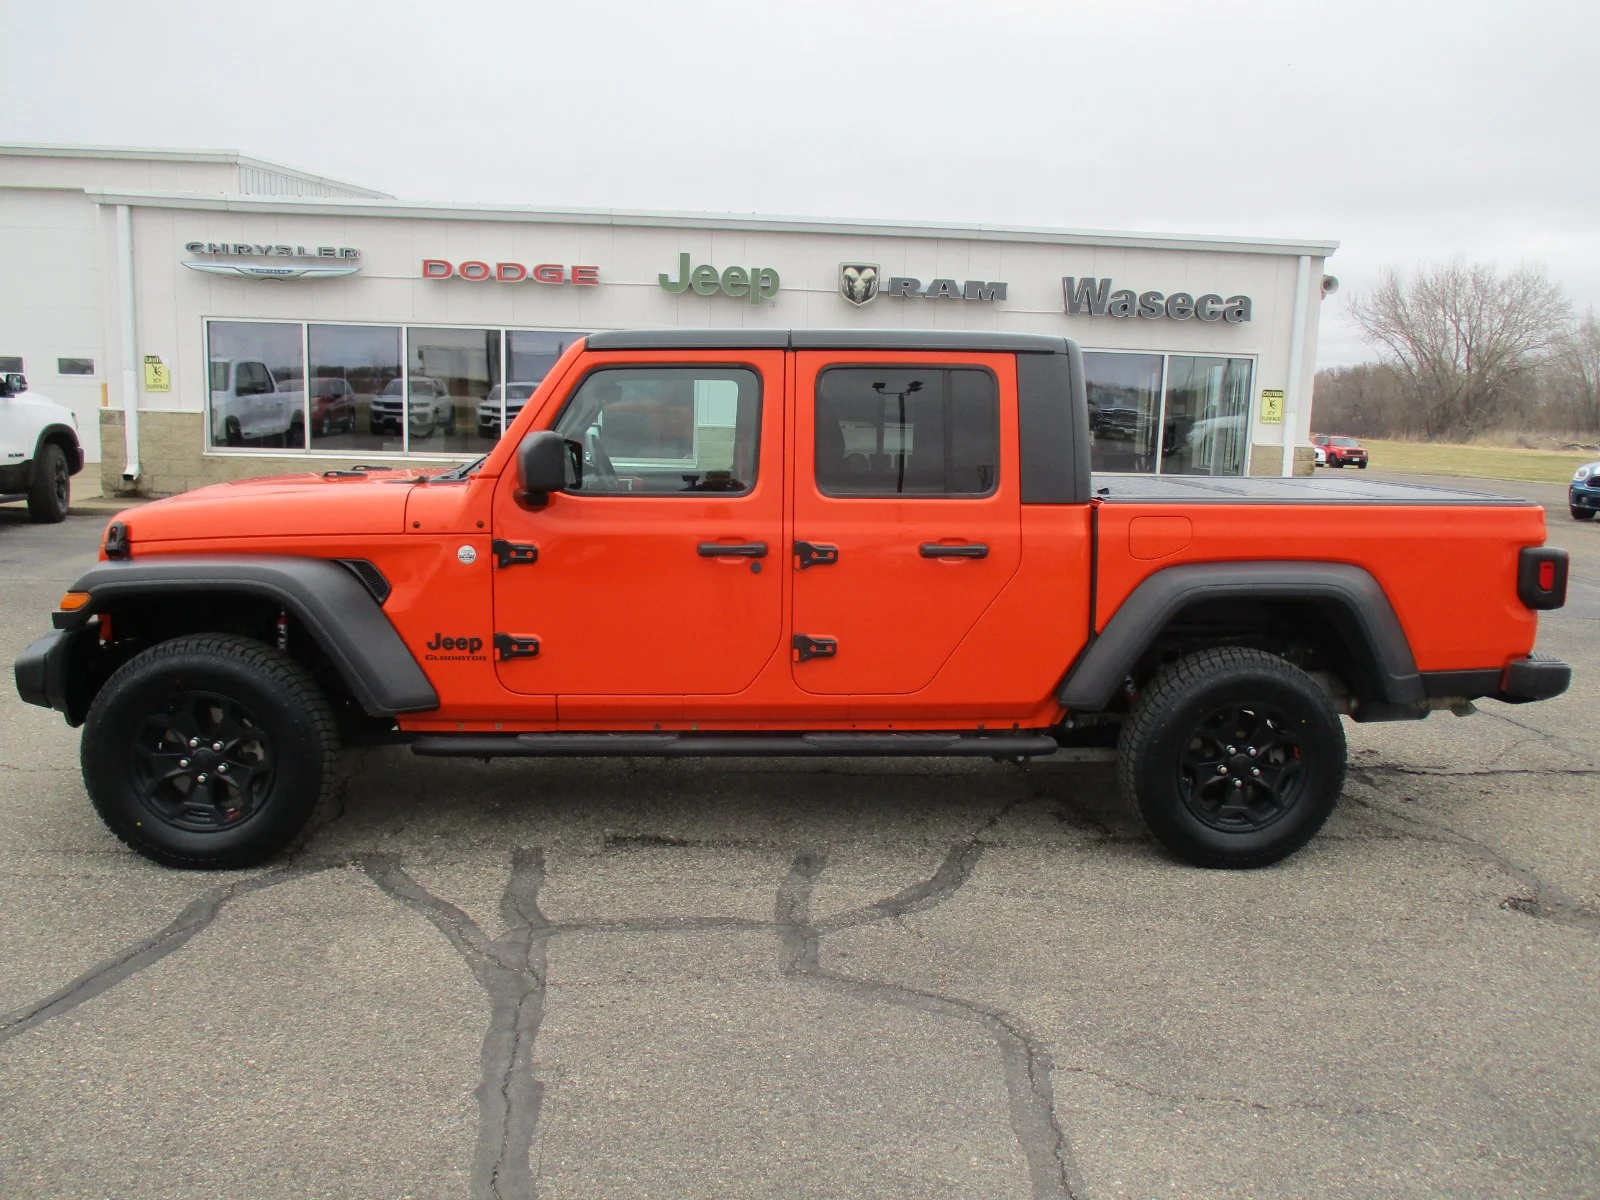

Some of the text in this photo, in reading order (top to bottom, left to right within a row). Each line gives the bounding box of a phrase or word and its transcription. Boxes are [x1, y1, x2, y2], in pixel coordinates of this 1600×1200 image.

[185, 241, 360, 259] CHRYSLER
[422, 259, 600, 286] DODGE
[658, 252, 780, 306] Jeep
[888, 276, 1009, 301] RAM
[1062, 276, 1252, 323] Waseca
[426, 632, 483, 654] Jeep
